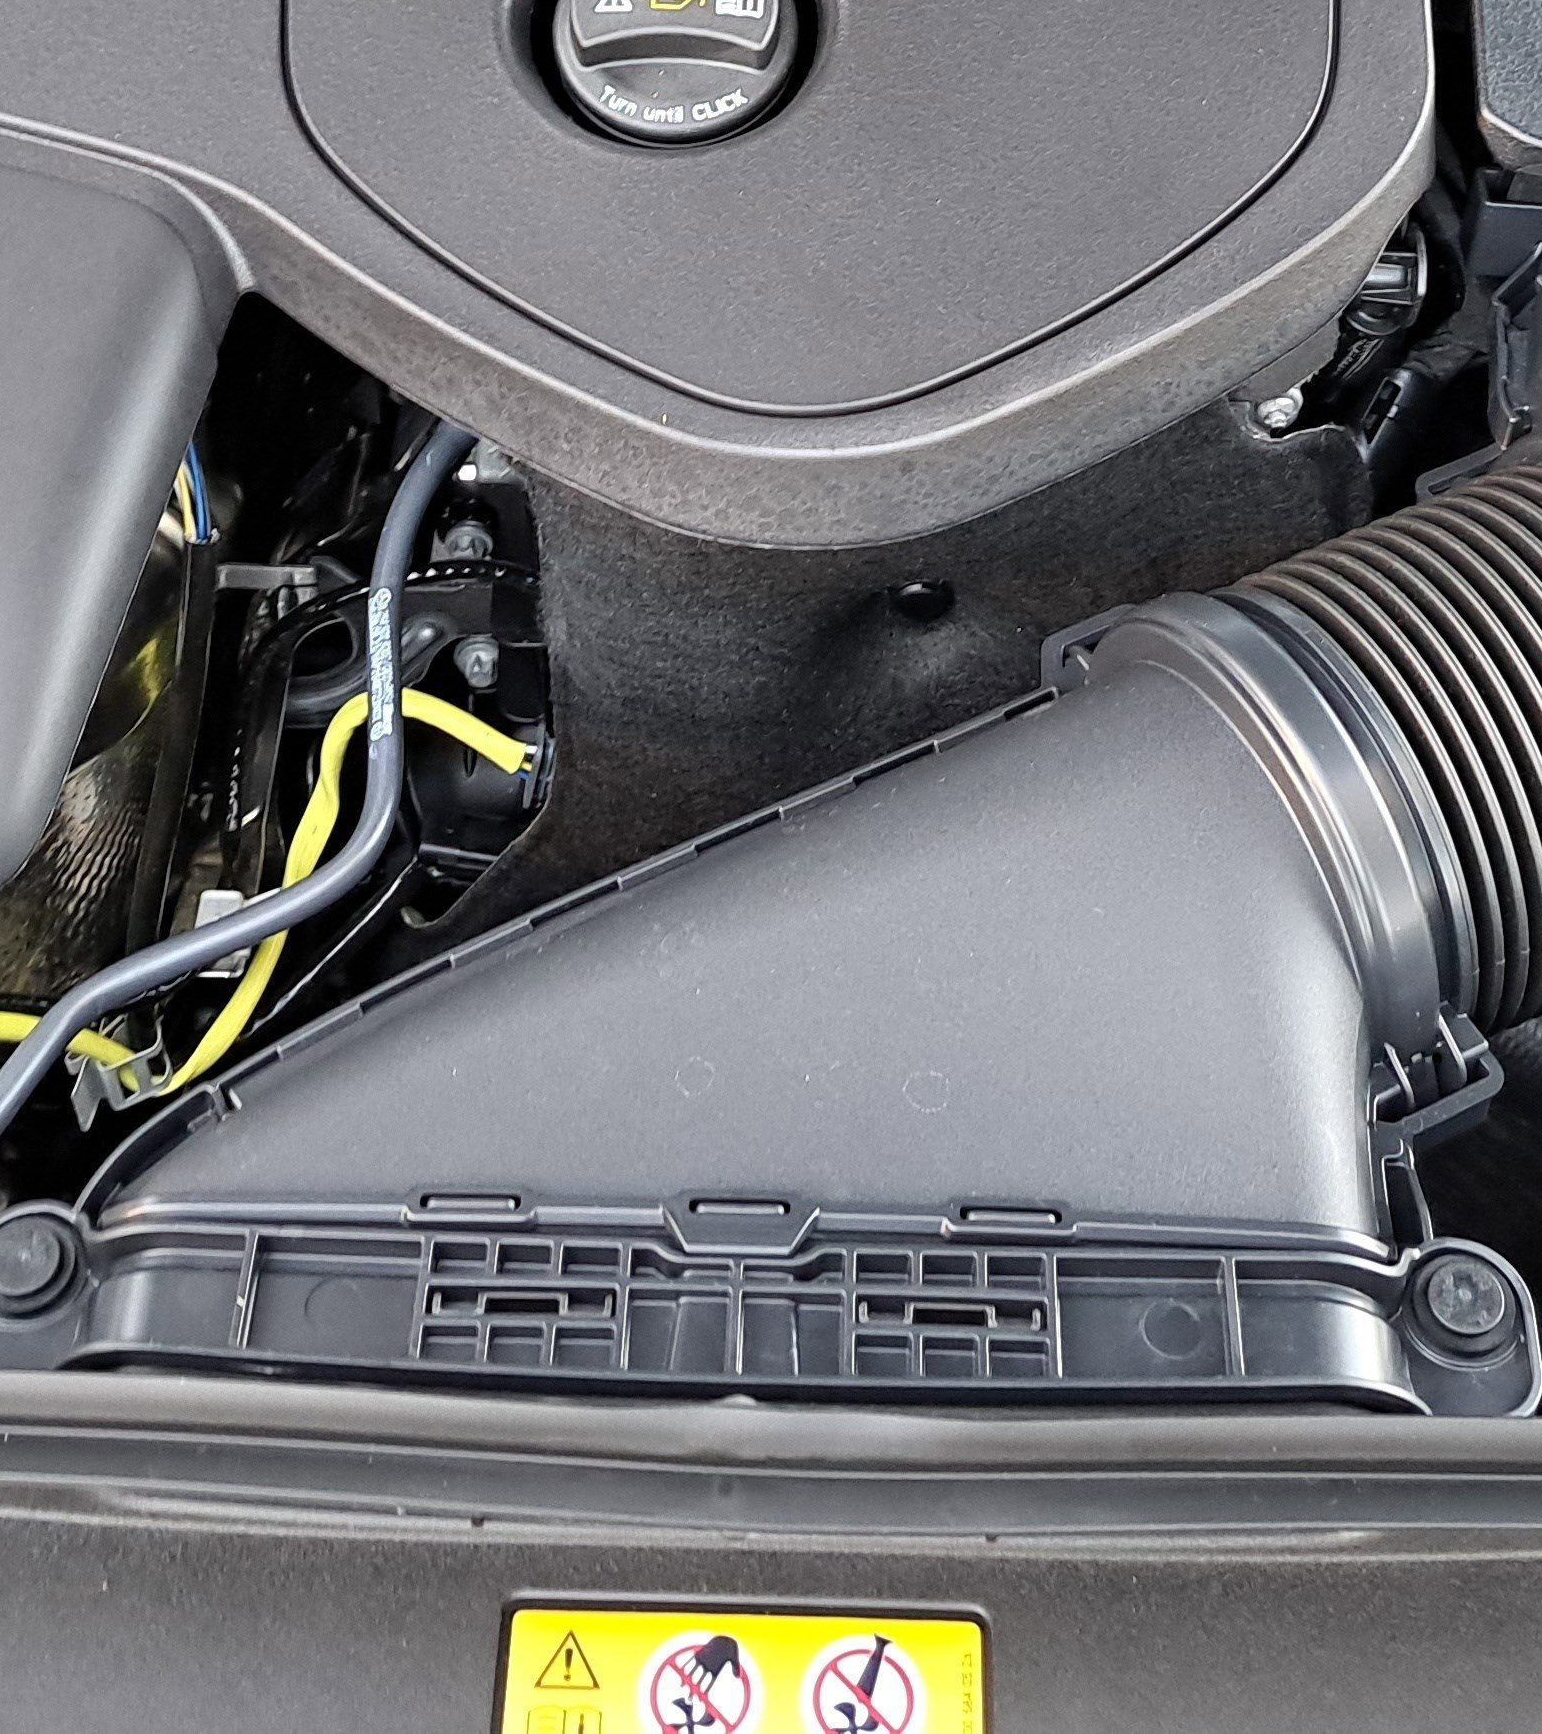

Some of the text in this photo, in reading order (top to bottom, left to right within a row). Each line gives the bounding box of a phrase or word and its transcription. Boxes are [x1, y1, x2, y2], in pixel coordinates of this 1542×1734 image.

[599, 84, 749, 123] Turn until CLICK
